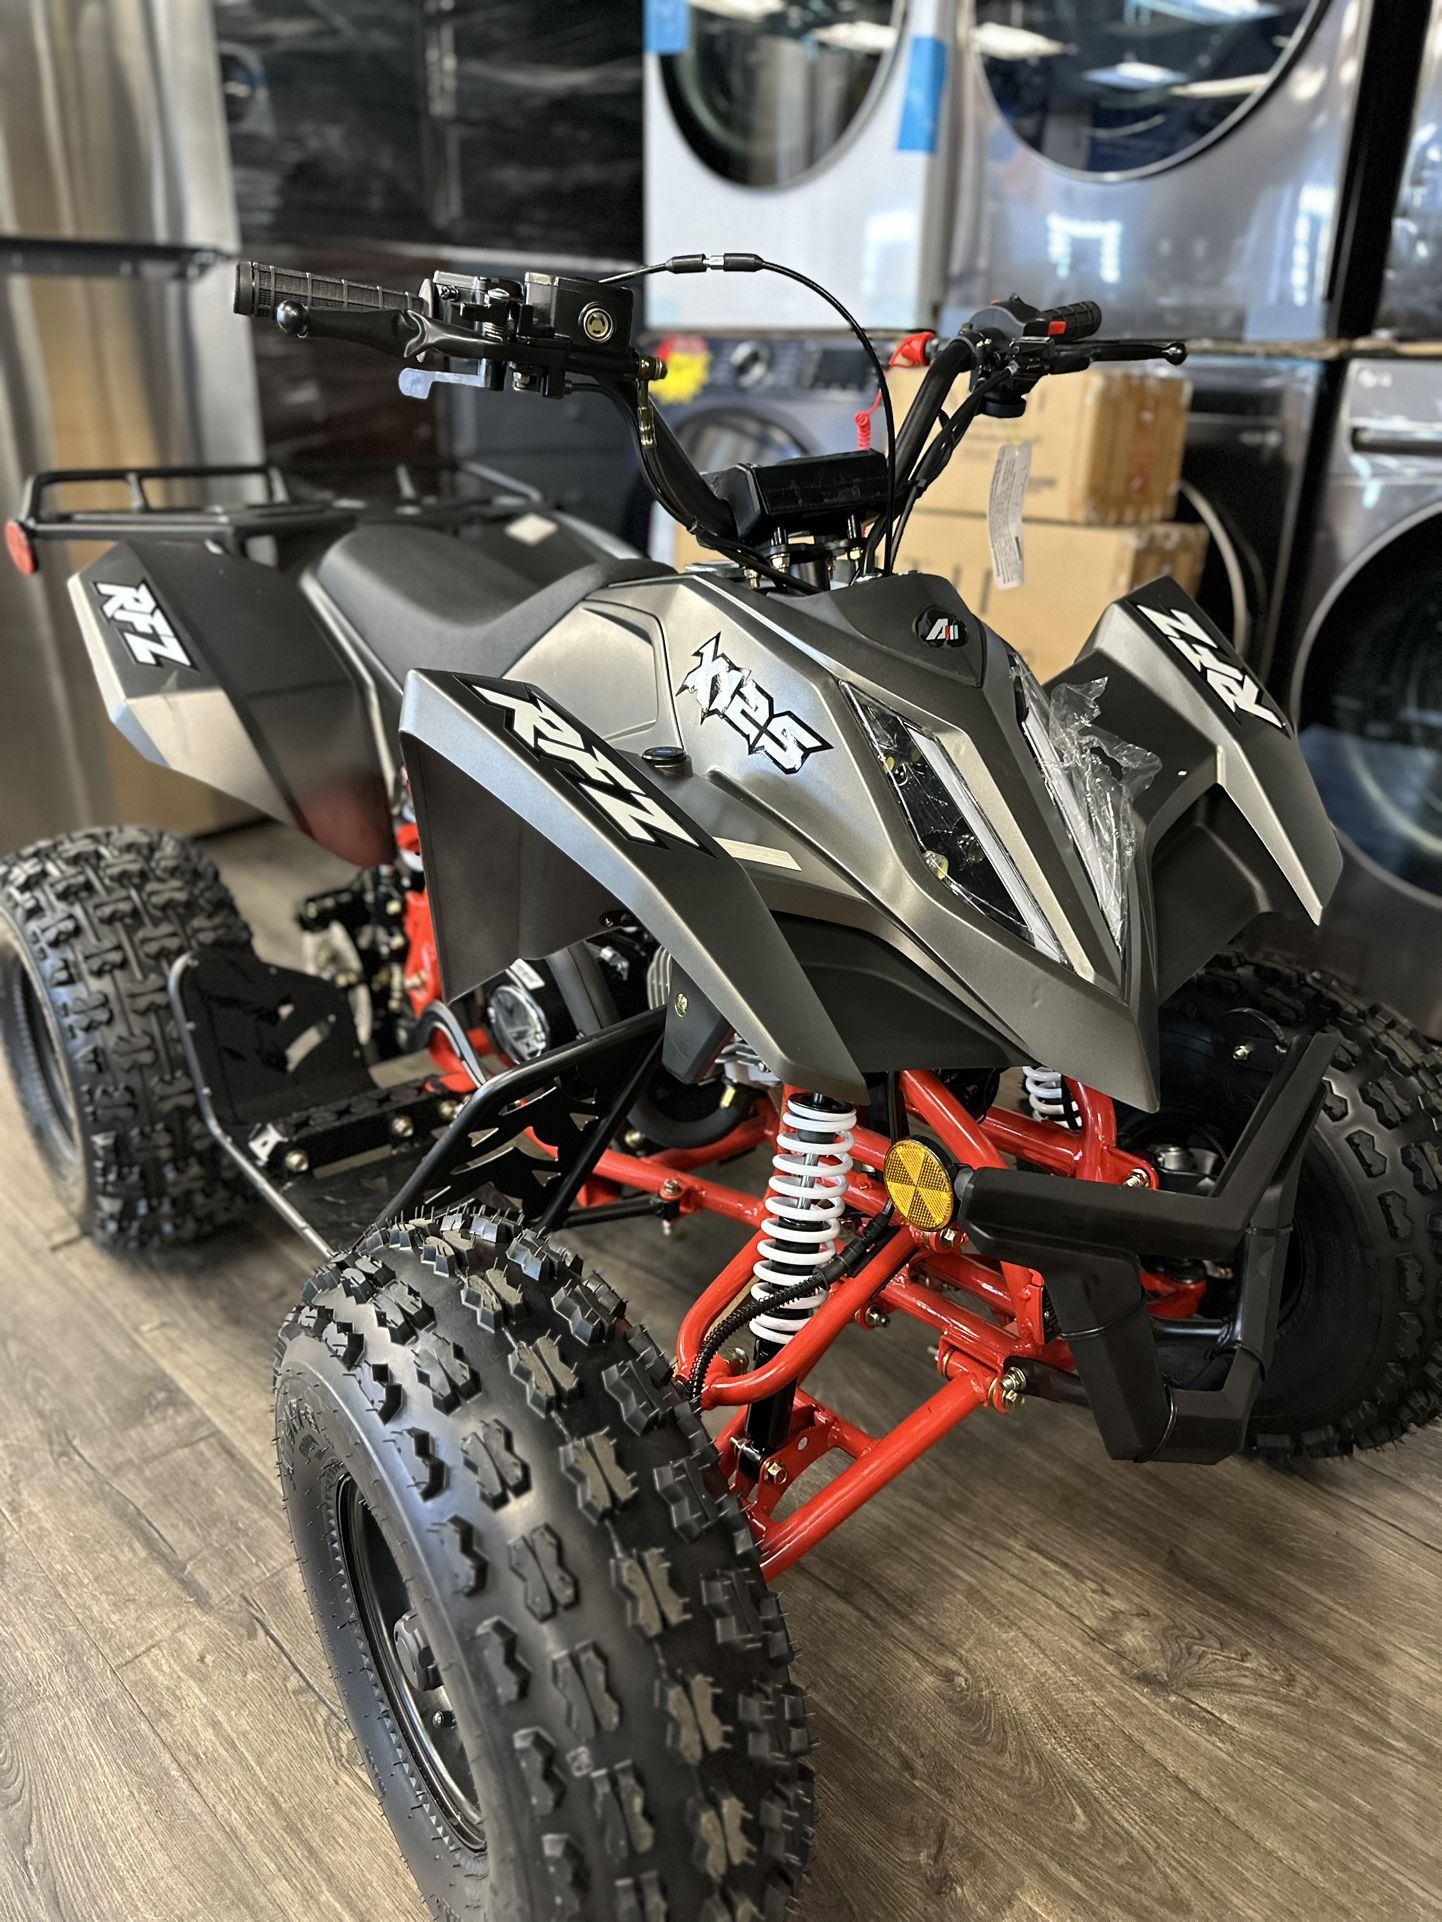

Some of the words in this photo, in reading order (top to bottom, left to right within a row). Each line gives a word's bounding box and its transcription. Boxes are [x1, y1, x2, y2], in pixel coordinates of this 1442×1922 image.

[94, 581, 194, 668] RFZ
[1135, 604, 1284, 729] RFZ
[471, 684, 701, 849] RFZ
